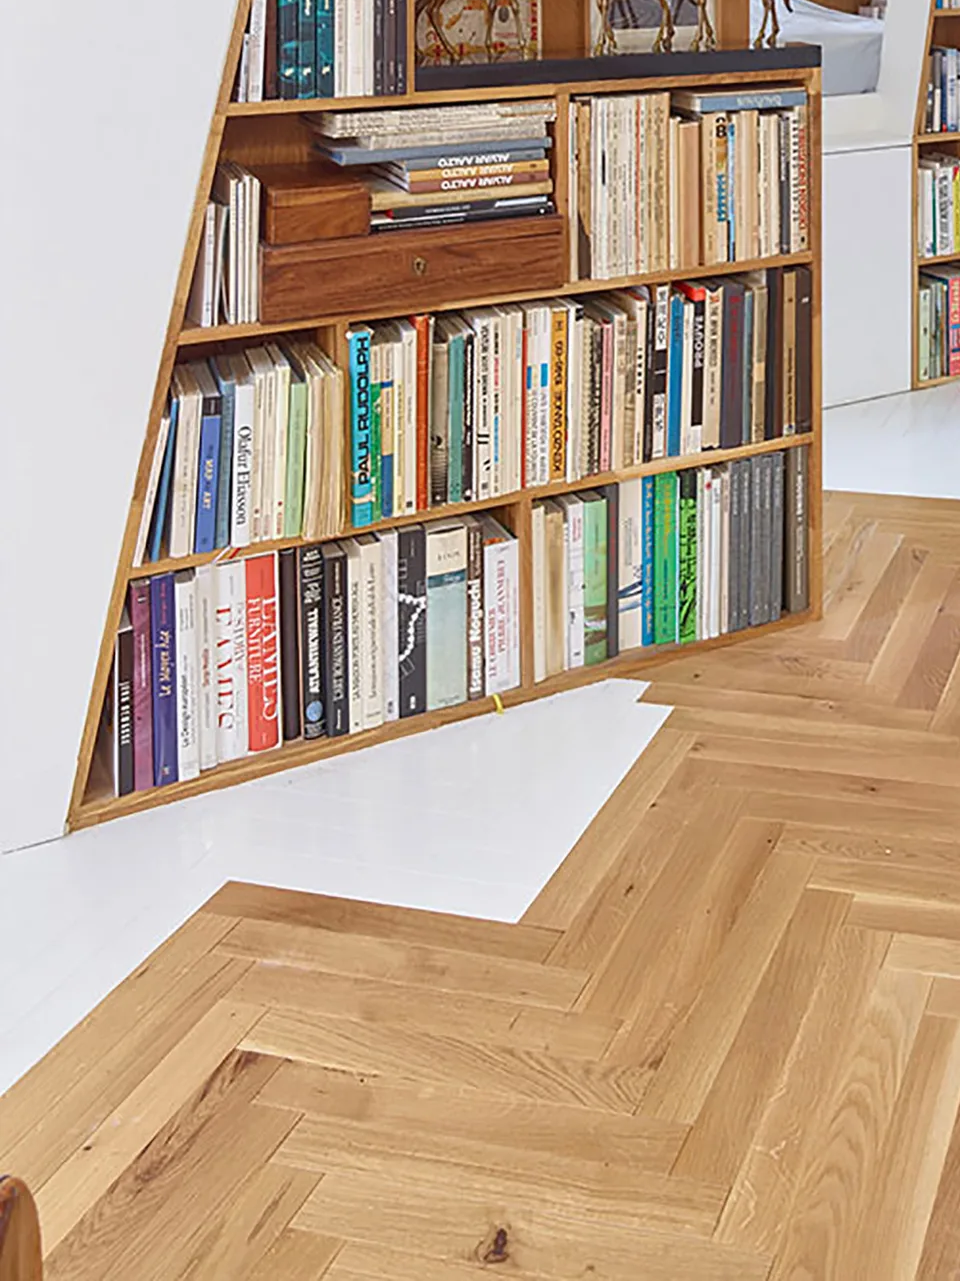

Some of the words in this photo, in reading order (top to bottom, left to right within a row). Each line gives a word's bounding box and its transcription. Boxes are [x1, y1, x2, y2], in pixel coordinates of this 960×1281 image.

[438, 155, 473, 168] AALTO
[441, 167, 477, 179] AALTO
[473, 153, 510, 163] ALVAR
[478, 164, 513, 174] ALVAR
[441, 178, 477, 191] AALTO
[478, 175, 512, 187] ALVAR
[356, 337, 369, 431] RUDOLPH
[554, 391, 564, 430] TANGE
[237, 426, 254, 469] Olafur
[356, 433, 370, 485] PAUL
[554, 429, 564, 472] KENZO
[235, 471, 251, 526] Eliasson
[331, 596, 343, 630] FRANCE
[467, 578, 484, 642] Noguchi
[233, 617, 245, 666] STORY
[247, 597, 262, 685] FURNITURE
[262, 597, 278, 721] EAMES
[308, 607, 321, 693] ATLANTIKWALL
[158, 650, 175, 682] Moyen
[217, 606, 234, 730] EAMES
[469, 646, 482, 693] Isamu
[158, 685, 171, 698] Le
[180, 710, 192, 737] Design
